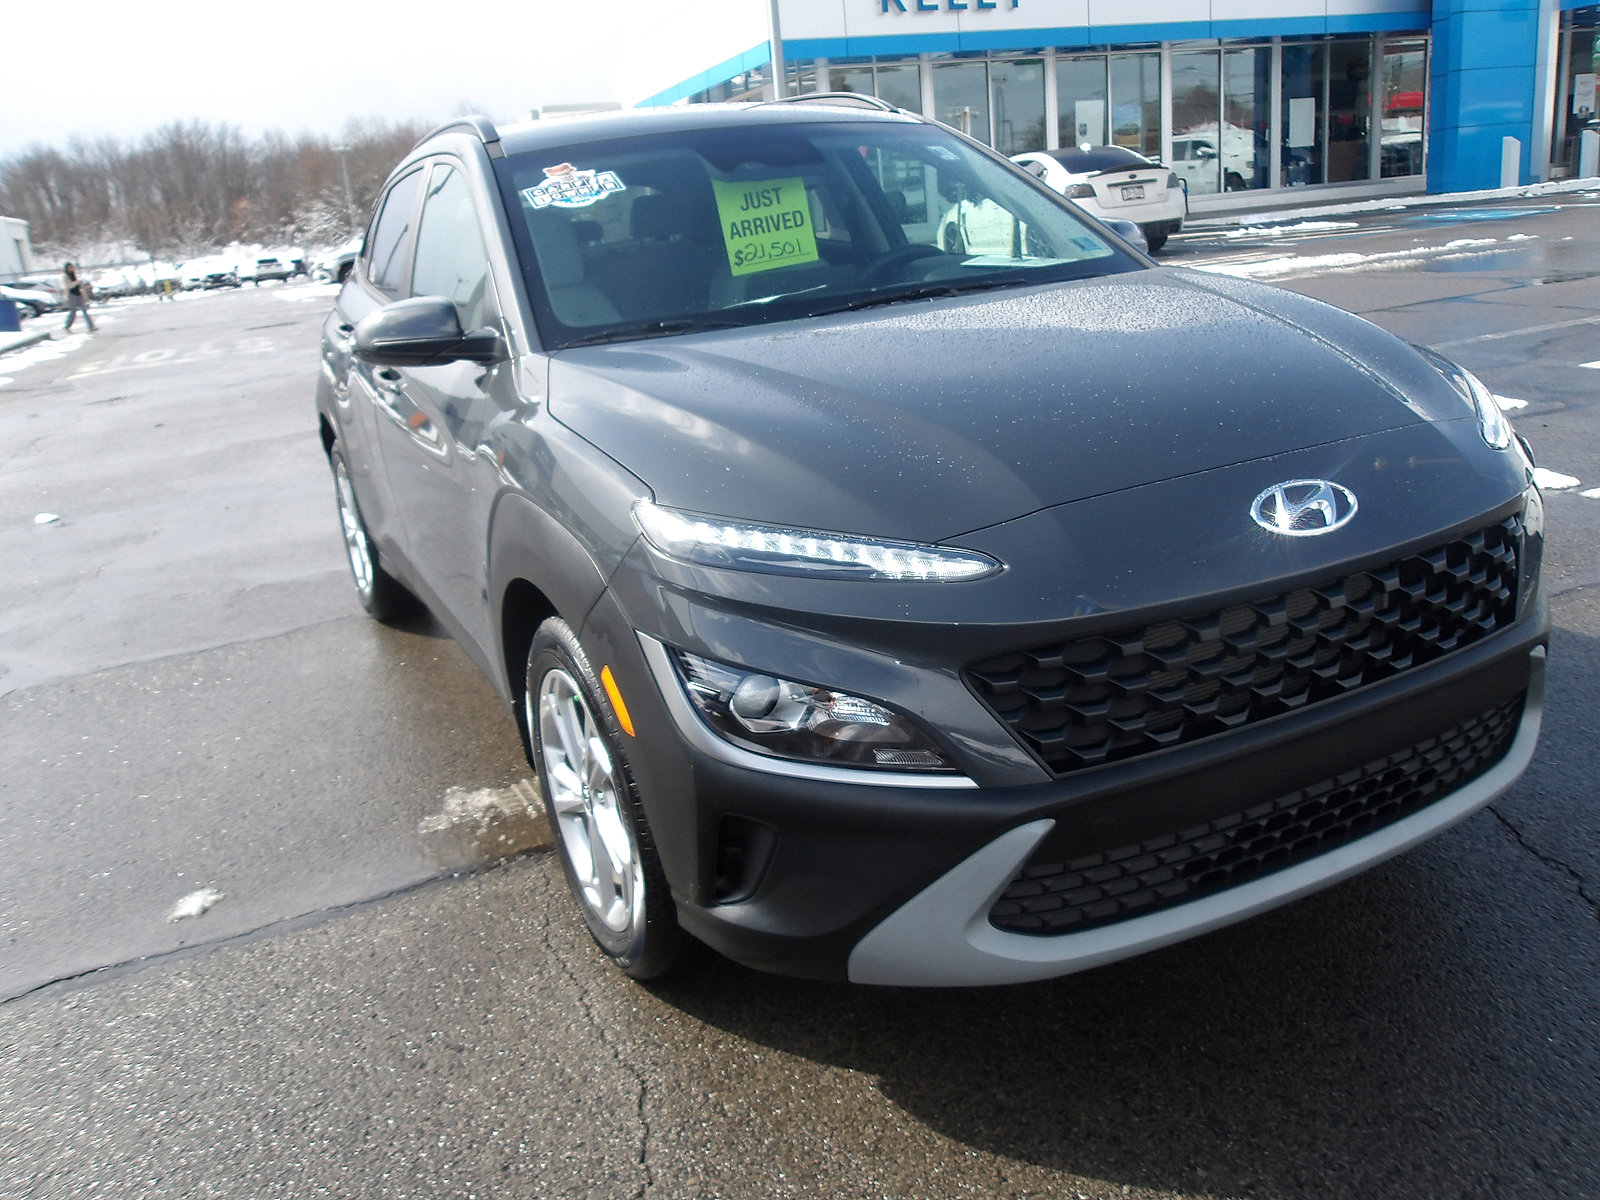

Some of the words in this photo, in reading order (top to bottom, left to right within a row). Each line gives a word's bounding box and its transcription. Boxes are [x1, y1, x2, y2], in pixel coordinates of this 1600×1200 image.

[740, 187, 782, 211] JUST
[730, 210, 805, 240] ARRIVED
[734, 239, 802, 267] $21,501
